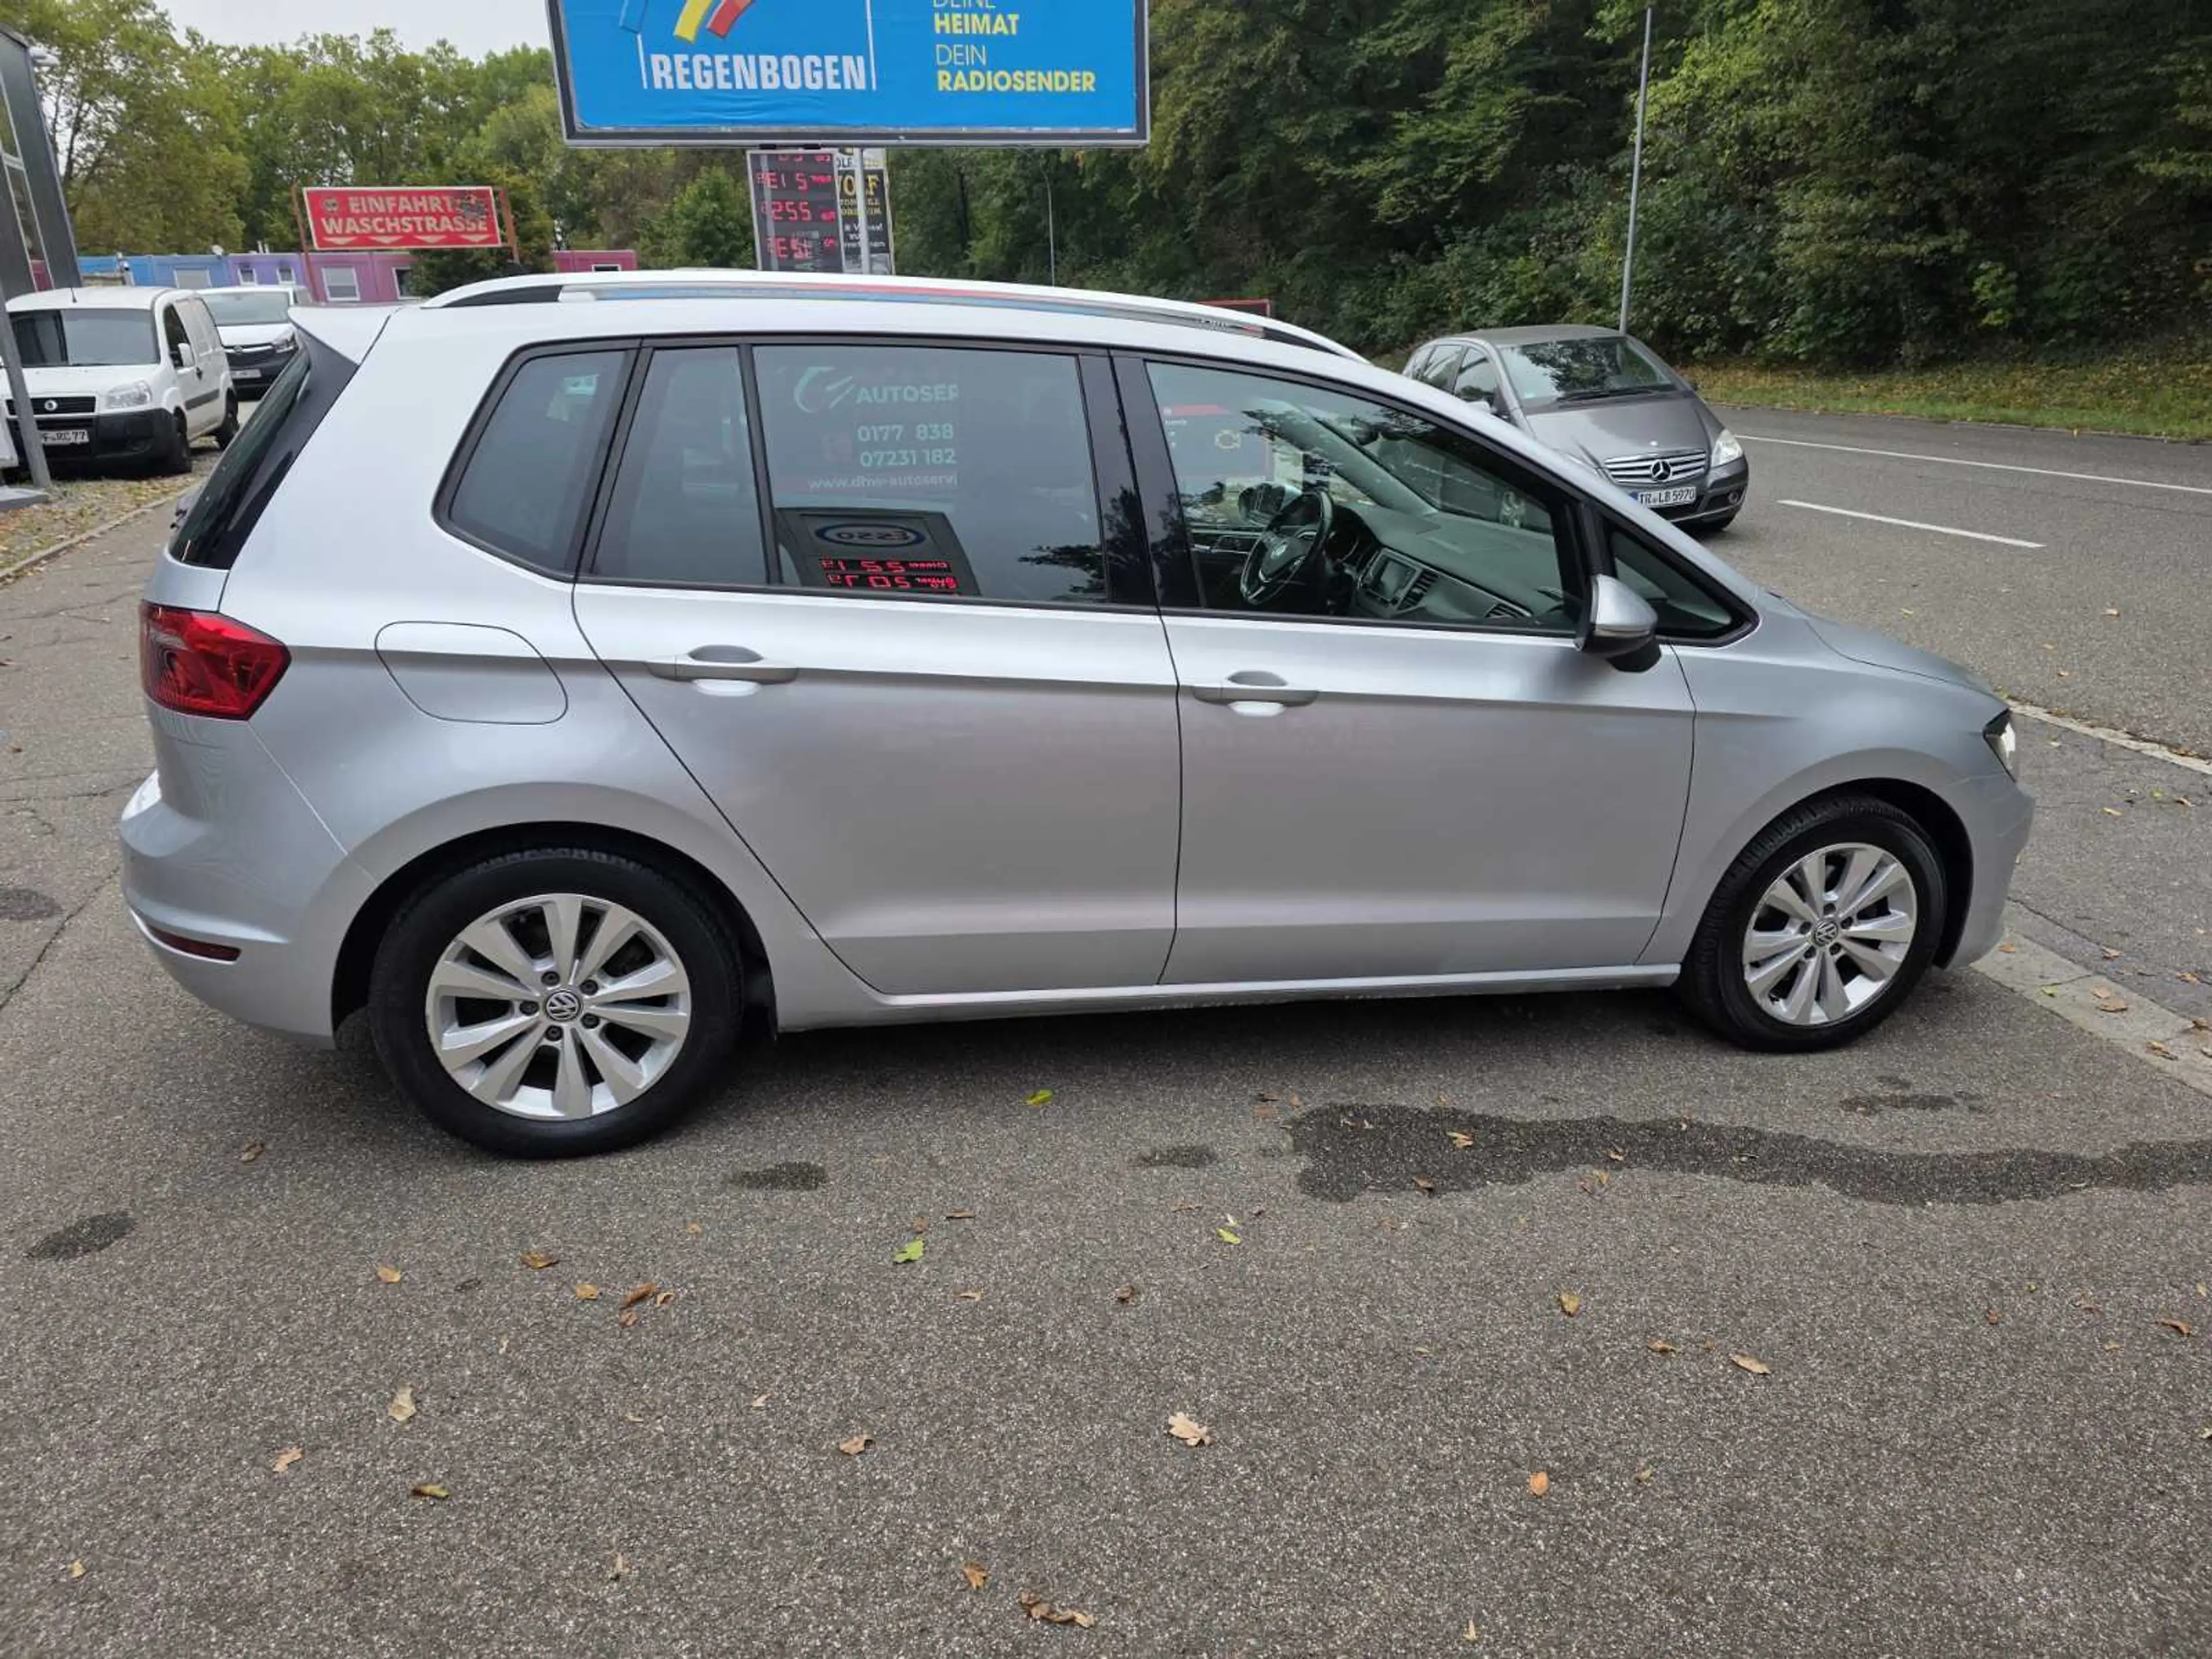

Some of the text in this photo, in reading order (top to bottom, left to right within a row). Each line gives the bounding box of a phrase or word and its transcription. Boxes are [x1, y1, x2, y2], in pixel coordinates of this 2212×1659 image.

[934, 13, 1019, 35] HEIMAT
[935, 44, 986, 66] DEIN
[650, 54, 866, 89] REGENBOGEN
[937, 69, 1096, 92] RADIOSENDER
[349, 195, 456, 214] EINFAHRT
[321, 217, 488, 234] WASCHSTRASSE
[857, 423, 954, 442] 0177 838
[859, 451, 916, 468] 07231
